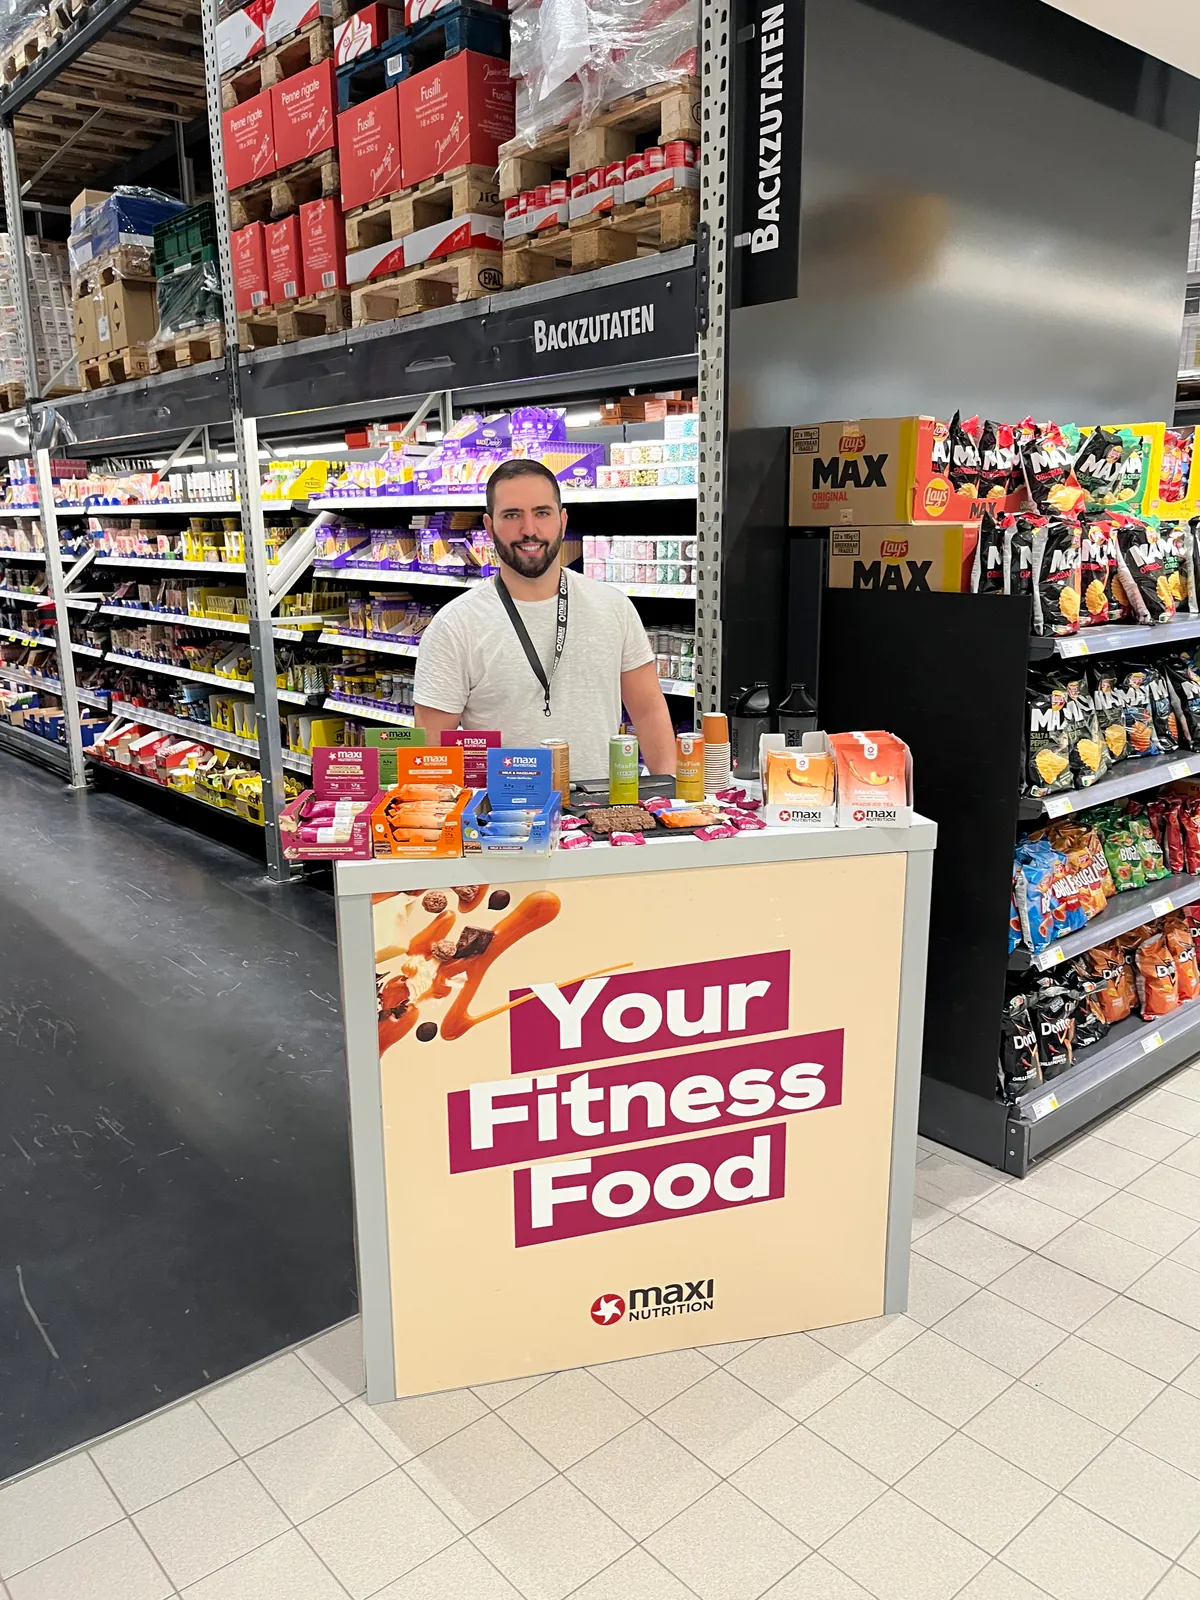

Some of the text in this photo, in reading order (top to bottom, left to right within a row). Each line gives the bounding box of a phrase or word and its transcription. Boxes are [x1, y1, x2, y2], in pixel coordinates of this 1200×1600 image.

[282, 89, 300, 106] Penne
[301, 79, 320, 98] rigate
[421, 77, 441, 102] Fusilli
[230, 116, 246, 132] Penne
[357, 110, 375, 132] Fusilli
[751, 3, 784, 254] BACKZUTATEN
[534, 304, 654, 354] BACKZUTATEN
[812, 454, 888, 489] MAX
[812, 491, 849, 501] ORIGINAL
[969, 502, 997, 519] MAX
[853, 560, 933, 592] MAX
[423, 755, 448, 763] maxi
[512, 756, 537, 764] maxi
[792, 810, 821, 819] maxi
[866, 810, 896, 818] maxi
[529, 976, 772, 1050] Your
[469, 1062, 827, 1150] Fitness
[530, 1135, 771, 1229] Food
[629, 1278, 714, 1310] maxi
[629, 1300, 714, 1322] NUTRITION
